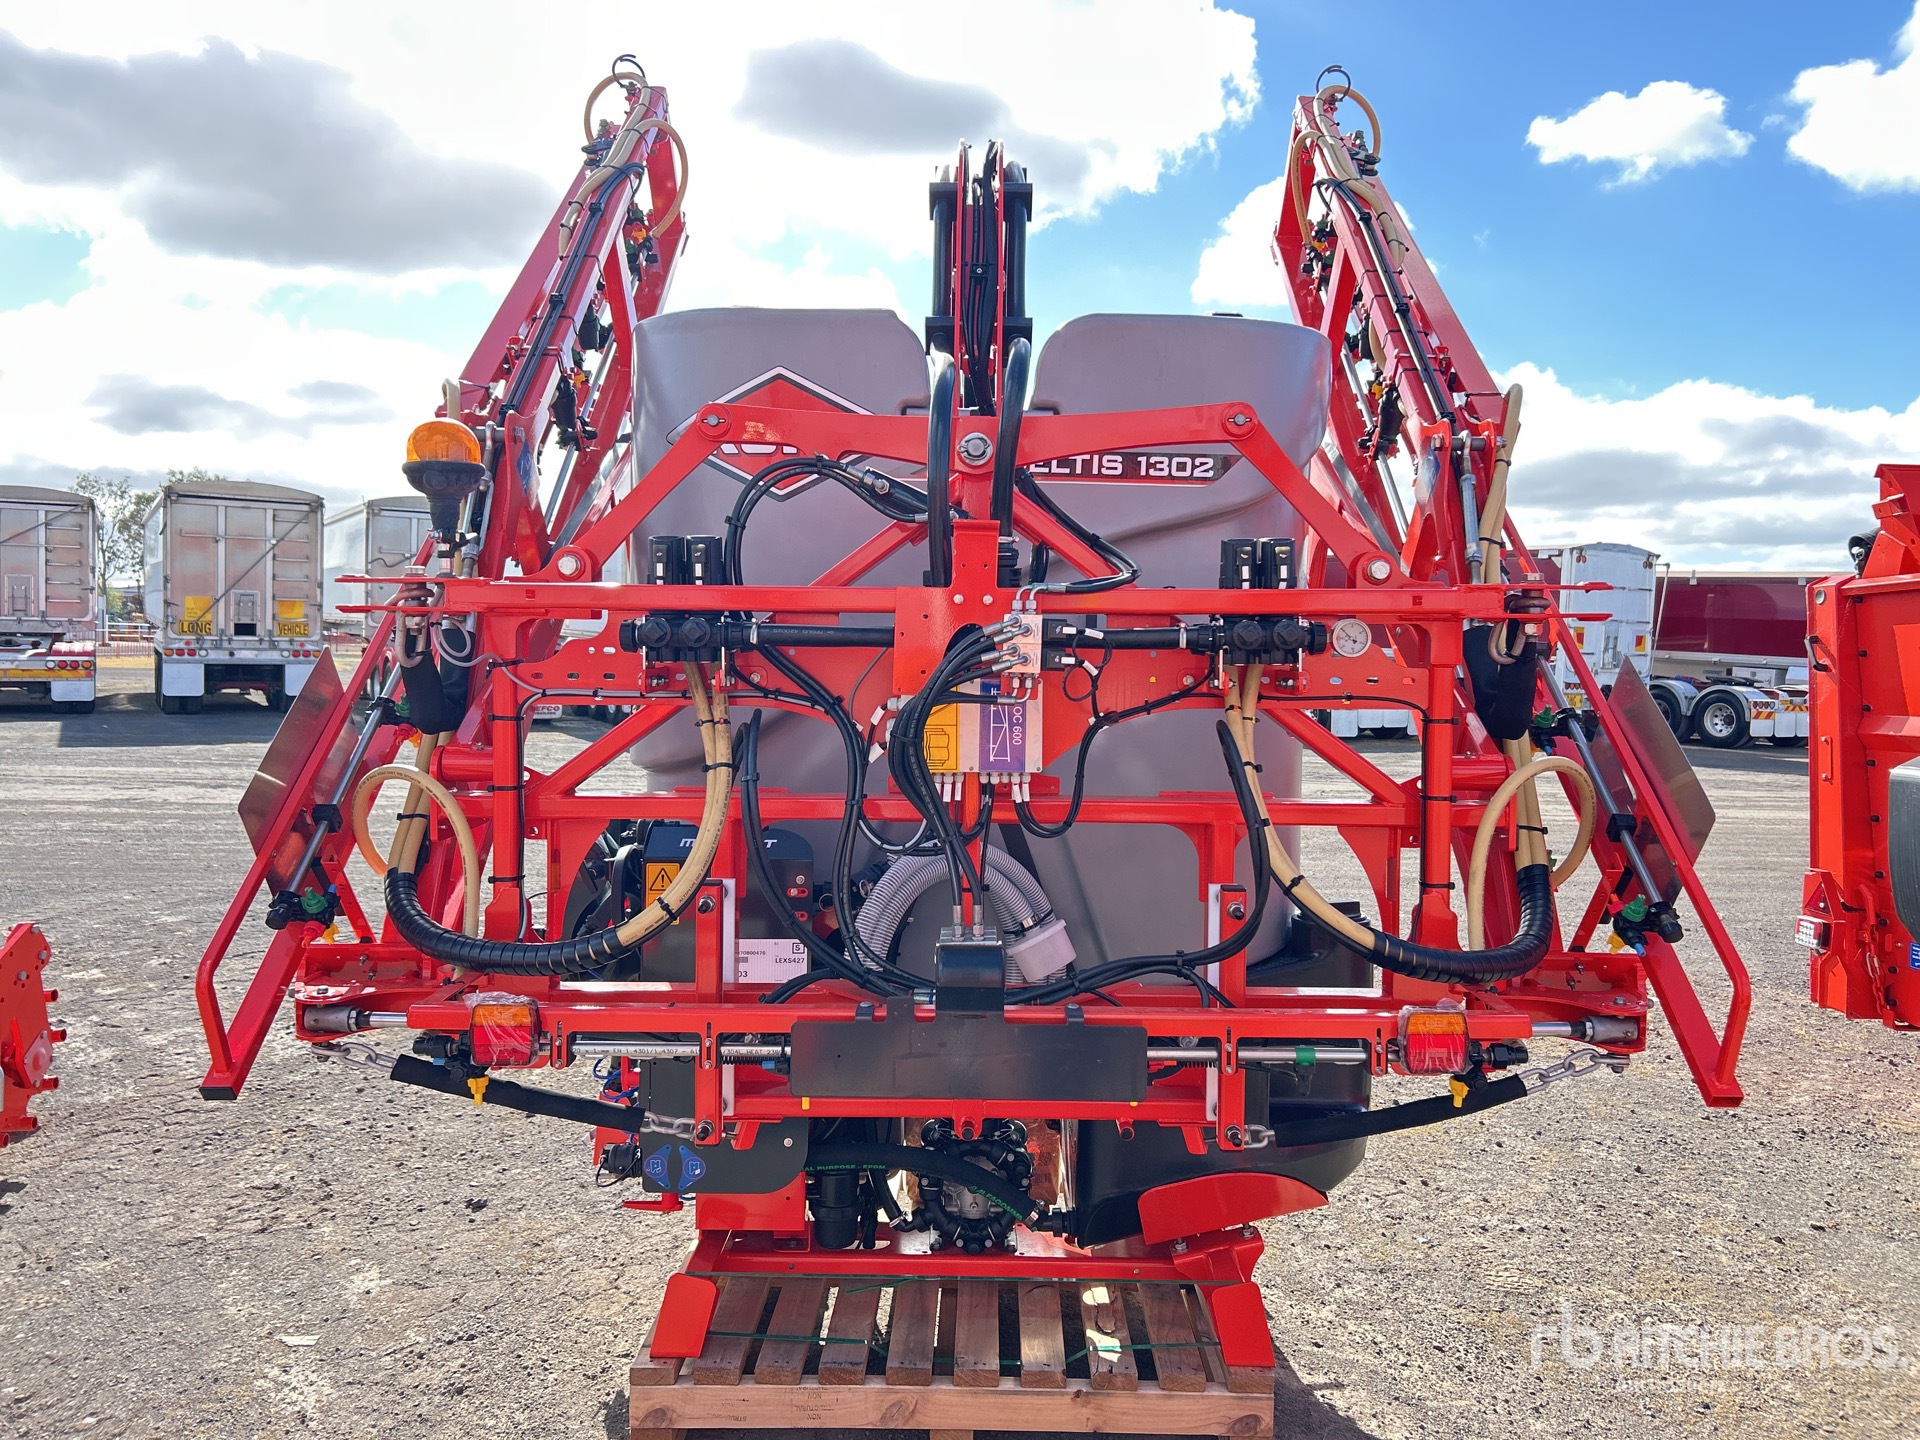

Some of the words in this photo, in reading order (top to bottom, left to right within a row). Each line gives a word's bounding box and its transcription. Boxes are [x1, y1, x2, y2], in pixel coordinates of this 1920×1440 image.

[1024, 454, 1123, 476] ELTIS
[1137, 456, 1214, 478] 1302
[180, 622, 212, 635] LONG
[278, 622, 308, 636] VEHICLE
[1012, 726, 1022, 745] 600
